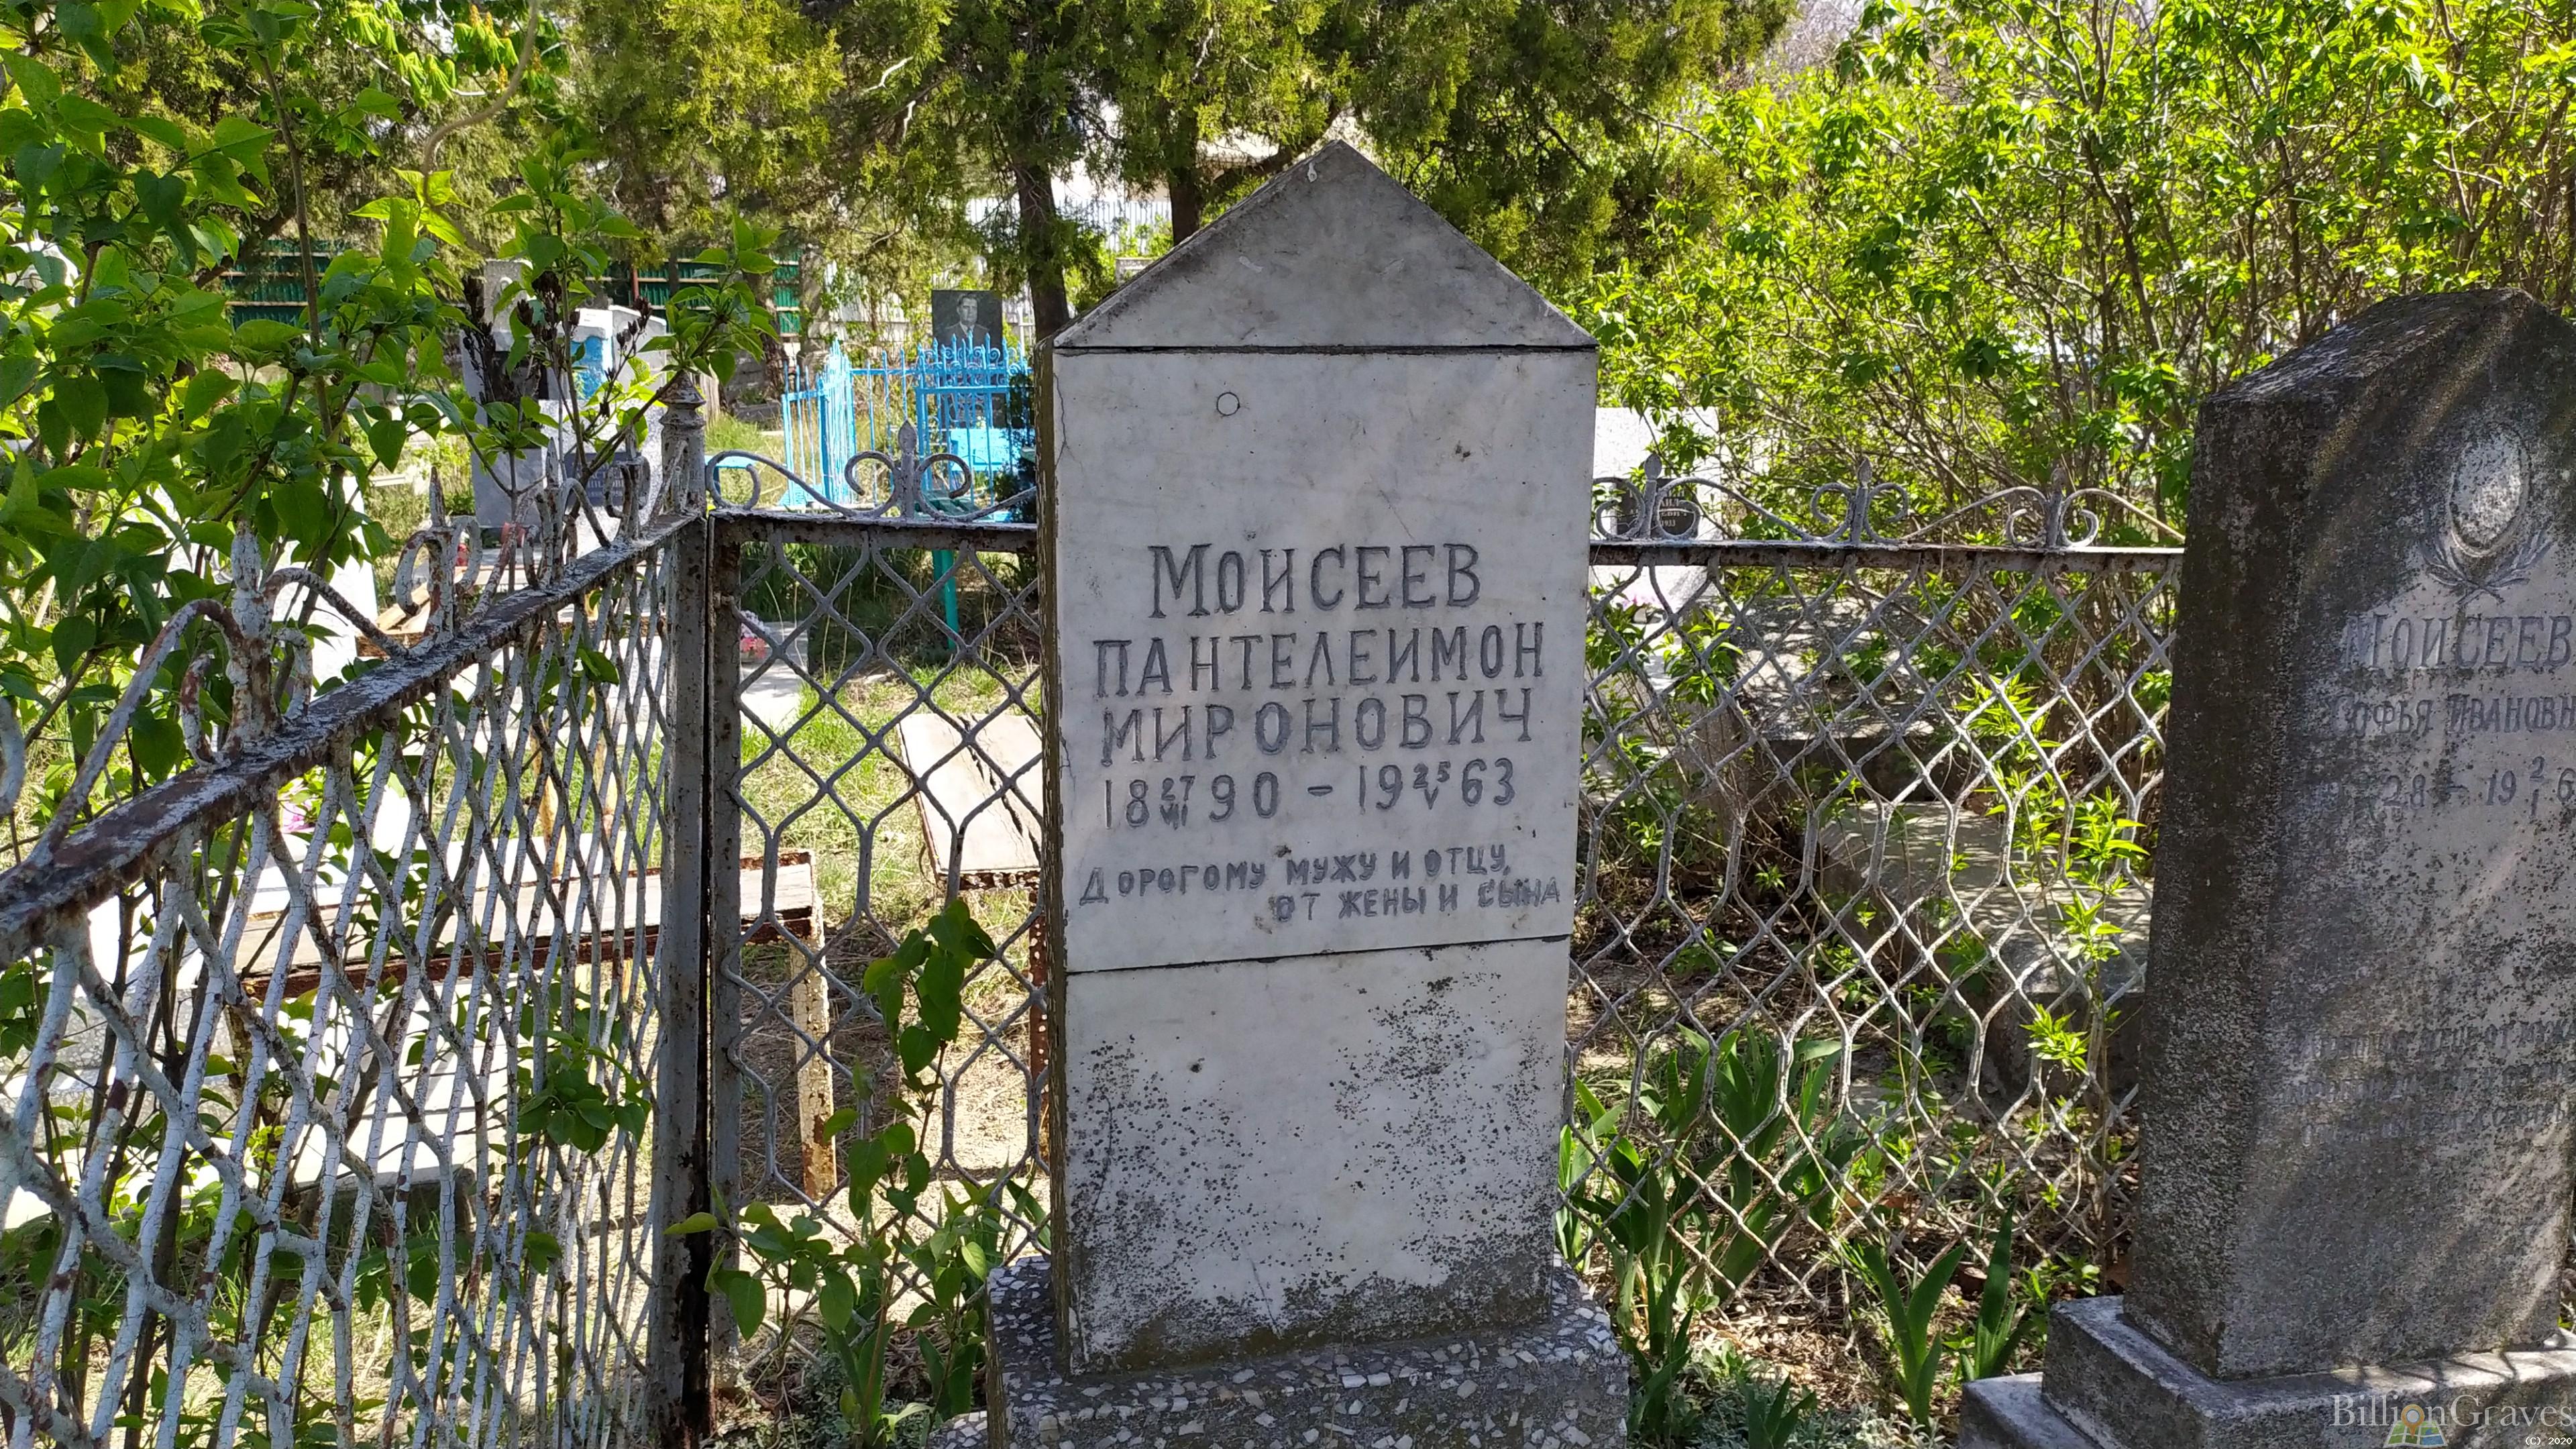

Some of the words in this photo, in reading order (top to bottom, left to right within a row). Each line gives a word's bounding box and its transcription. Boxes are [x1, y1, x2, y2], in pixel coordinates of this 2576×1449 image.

[1147, 543, 1481, 618] МОИСЕЕВ
[1093, 622, 1544, 698] ПАНТЕЛЕИМОН
[1100, 688, 1532, 767] МИРОНОВИЧ
[1079, 860, 1266, 906] ДОРОГОМУ
[1286, 851, 1376, 885] МУЖУ
[1391, 850, 1410, 880] И
[1424, 843, 1511, 878] ОТЦУ,
[1274, 892, 1321, 922] ОТ
[1338, 885, 1428, 920] ЖЕНЫ
[1439, 882, 1458, 912] И
[1477, 876, 1560, 908] СЫНА
